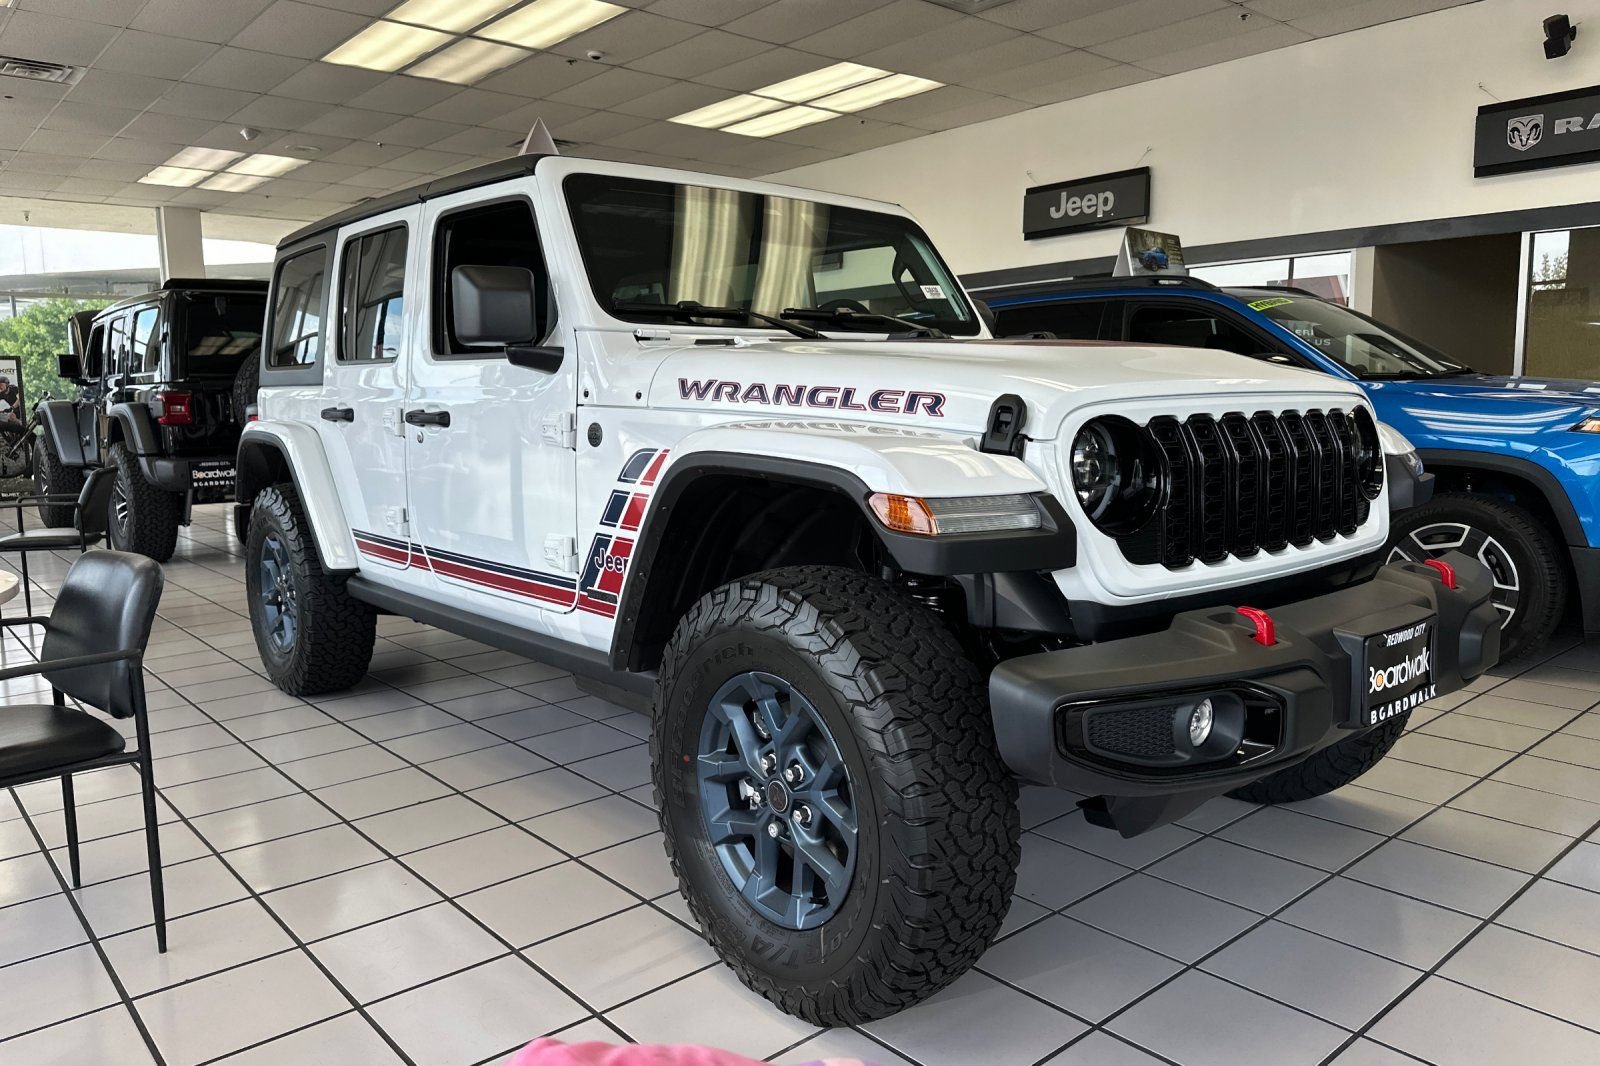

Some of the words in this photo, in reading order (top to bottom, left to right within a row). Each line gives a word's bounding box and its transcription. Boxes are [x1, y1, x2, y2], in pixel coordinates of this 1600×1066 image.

[1049, 191, 1115, 219] Jeep
[678, 377, 946, 417] WRANGLER
[1386, 627, 1414, 647] REDWOOD
[1414, 622, 1427, 638] CITY
[1370, 684, 1436, 724] BOARDWALK
